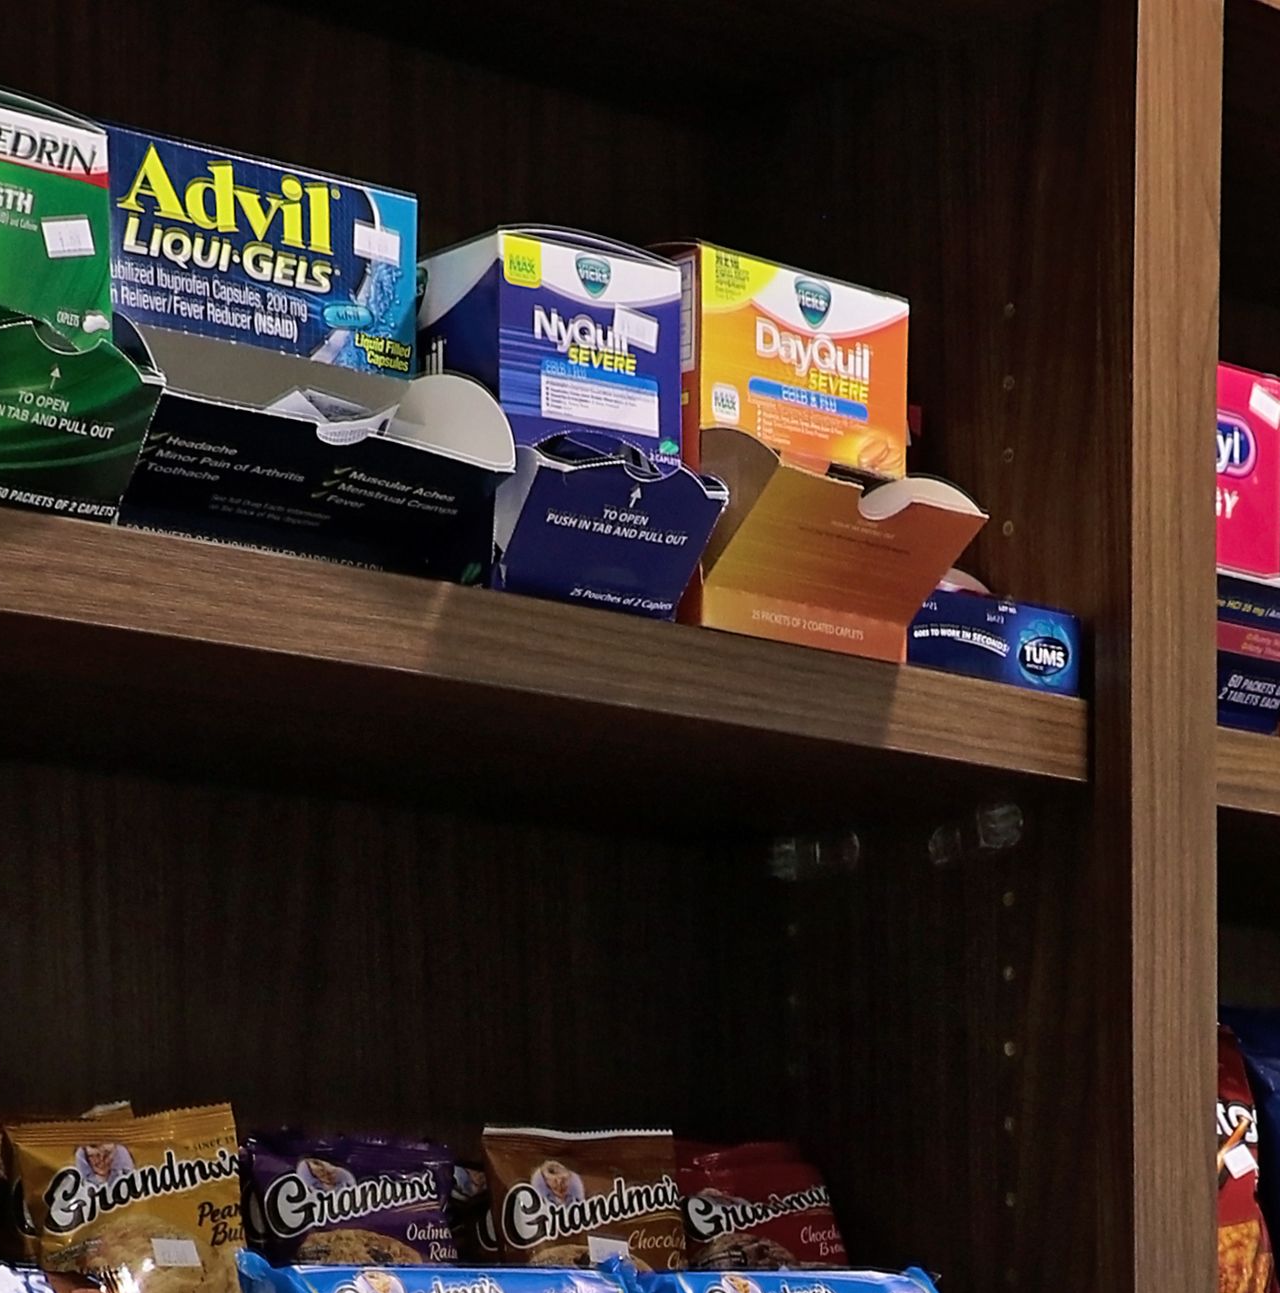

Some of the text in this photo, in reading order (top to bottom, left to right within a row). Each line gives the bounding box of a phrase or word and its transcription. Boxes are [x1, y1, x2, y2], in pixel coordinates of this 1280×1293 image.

[117, 142, 334, 256] Advil
[156, 266, 308, 321] Ibuprofen Capsules, 200 mg
[207, 304, 251, 330] Reducer
[254, 314, 298, 342] (NSAID)
[568, 344, 637, 376] SEVERE
[755, 316, 871, 384] DayQuil
[19, 390, 69, 413] TO OPEN
[809, 368, 869, 403] SEVERE
[8, 406, 29, 421] TAB
[31, 411, 57, 428] AND
[58, 419, 87, 436] PULL
[90, 425, 114, 440] OUT
[165, 435, 238, 457] Headache
[146, 461, 220, 482] Toothache
[155, 449, 305, 484] Minor Pain of Arthritis
[327, 494, 366, 509] Fever
[337, 481, 406, 505] Menstrual
[348, 469, 456, 502] Muscular Aches
[9, 488, 115, 517] PACKETS OF 2 CAPLETS
[603, 509, 649, 526] TO OPEN
[546, 513, 688, 547] PUSH IN TAB AND PULL OUT
[583, 590, 621, 604] Pouches
[1024, 644, 1065, 668] TUMS
[1226, 690, 1259, 706] TABLETS
[1242, 677, 1277, 694] PACKETS
[43, 1148, 241, 1236] Grandma's
[502, 1174, 680, 1250] Grandma's
